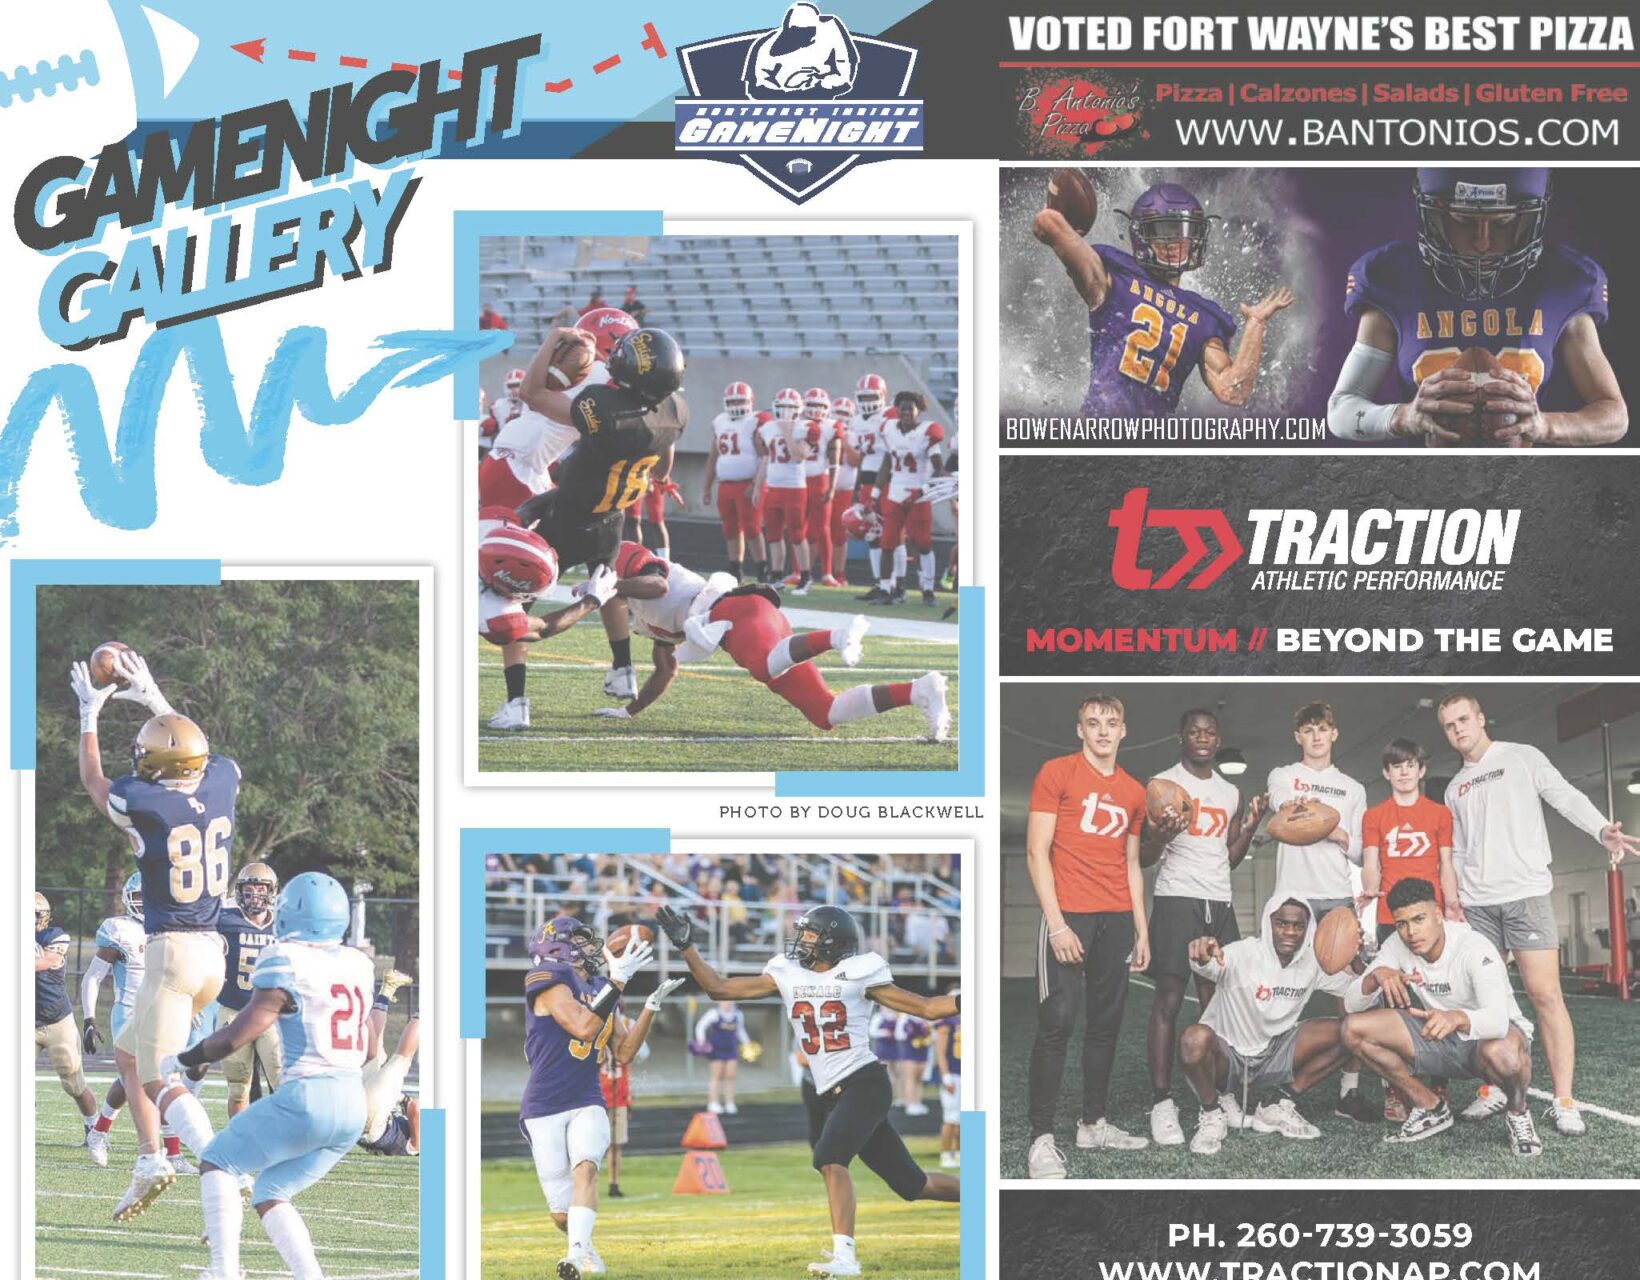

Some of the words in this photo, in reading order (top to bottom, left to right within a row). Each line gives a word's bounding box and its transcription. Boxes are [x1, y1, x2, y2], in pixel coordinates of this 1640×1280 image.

[1009, 16, 1132, 51] VOTED
[1143, 16, 1239, 51] FORT
[1425, 16, 1520, 51] BEST
[1530, 16, 1634, 50] PIZZA
[1052, 85, 1140, 111] Antonio's
[1156, 83, 1223, 102] Pizza
[1240, 83, 1357, 103] Calzones
[1374, 83, 1459, 102] Salads
[1476, 83, 1563, 103] Gluten
[1571, 83, 1628, 102] Free
[1041, 112, 1090, 137] Pizza
[1175, 118, 1619, 146] WWW.BANTONIOS.COM
[13, 33, 550, 256] GAMENIGHT
[38, 168, 423, 352] GALLERY
[1129, 278, 1200, 326] ANGOLA
[1416, 307, 1544, 340] ANGOLA
[1118, 302, 1189, 392] 21
[1006, 416, 1327, 441] BOWENARROWPHOTOGRAPHY.COM
[718, 432, 742, 456] 61
[592, 454, 661, 513] 18
[1247, 508, 1522, 566] TRACTION
[1250, 569, 1348, 591] ATHLETIC
[1353, 569, 1506, 591] PERFORMANCE
[1026, 627, 1237, 653] MOMENTUM
[1277, 627, 1424, 653] BEYOND
[1433, 628, 1502, 652] THE
[1512, 627, 1614, 653] GAME
[1311, 784, 1347, 797] TRACTION
[1471, 768, 1506, 786] TRACTION
[719, 805, 783, 819] PHOTO
[789, 805, 812, 819] BY
[817, 805, 871, 819] DOUG
[877, 805, 984, 819] BLACKWELL
[166, 815, 233, 904] 86
[331, 983, 365, 1052] 21
[791, 1000, 851, 1055] 32
[1169, 1223, 1226, 1248] PH.
[1236, 1222, 1473, 1248] 260-739-3059
